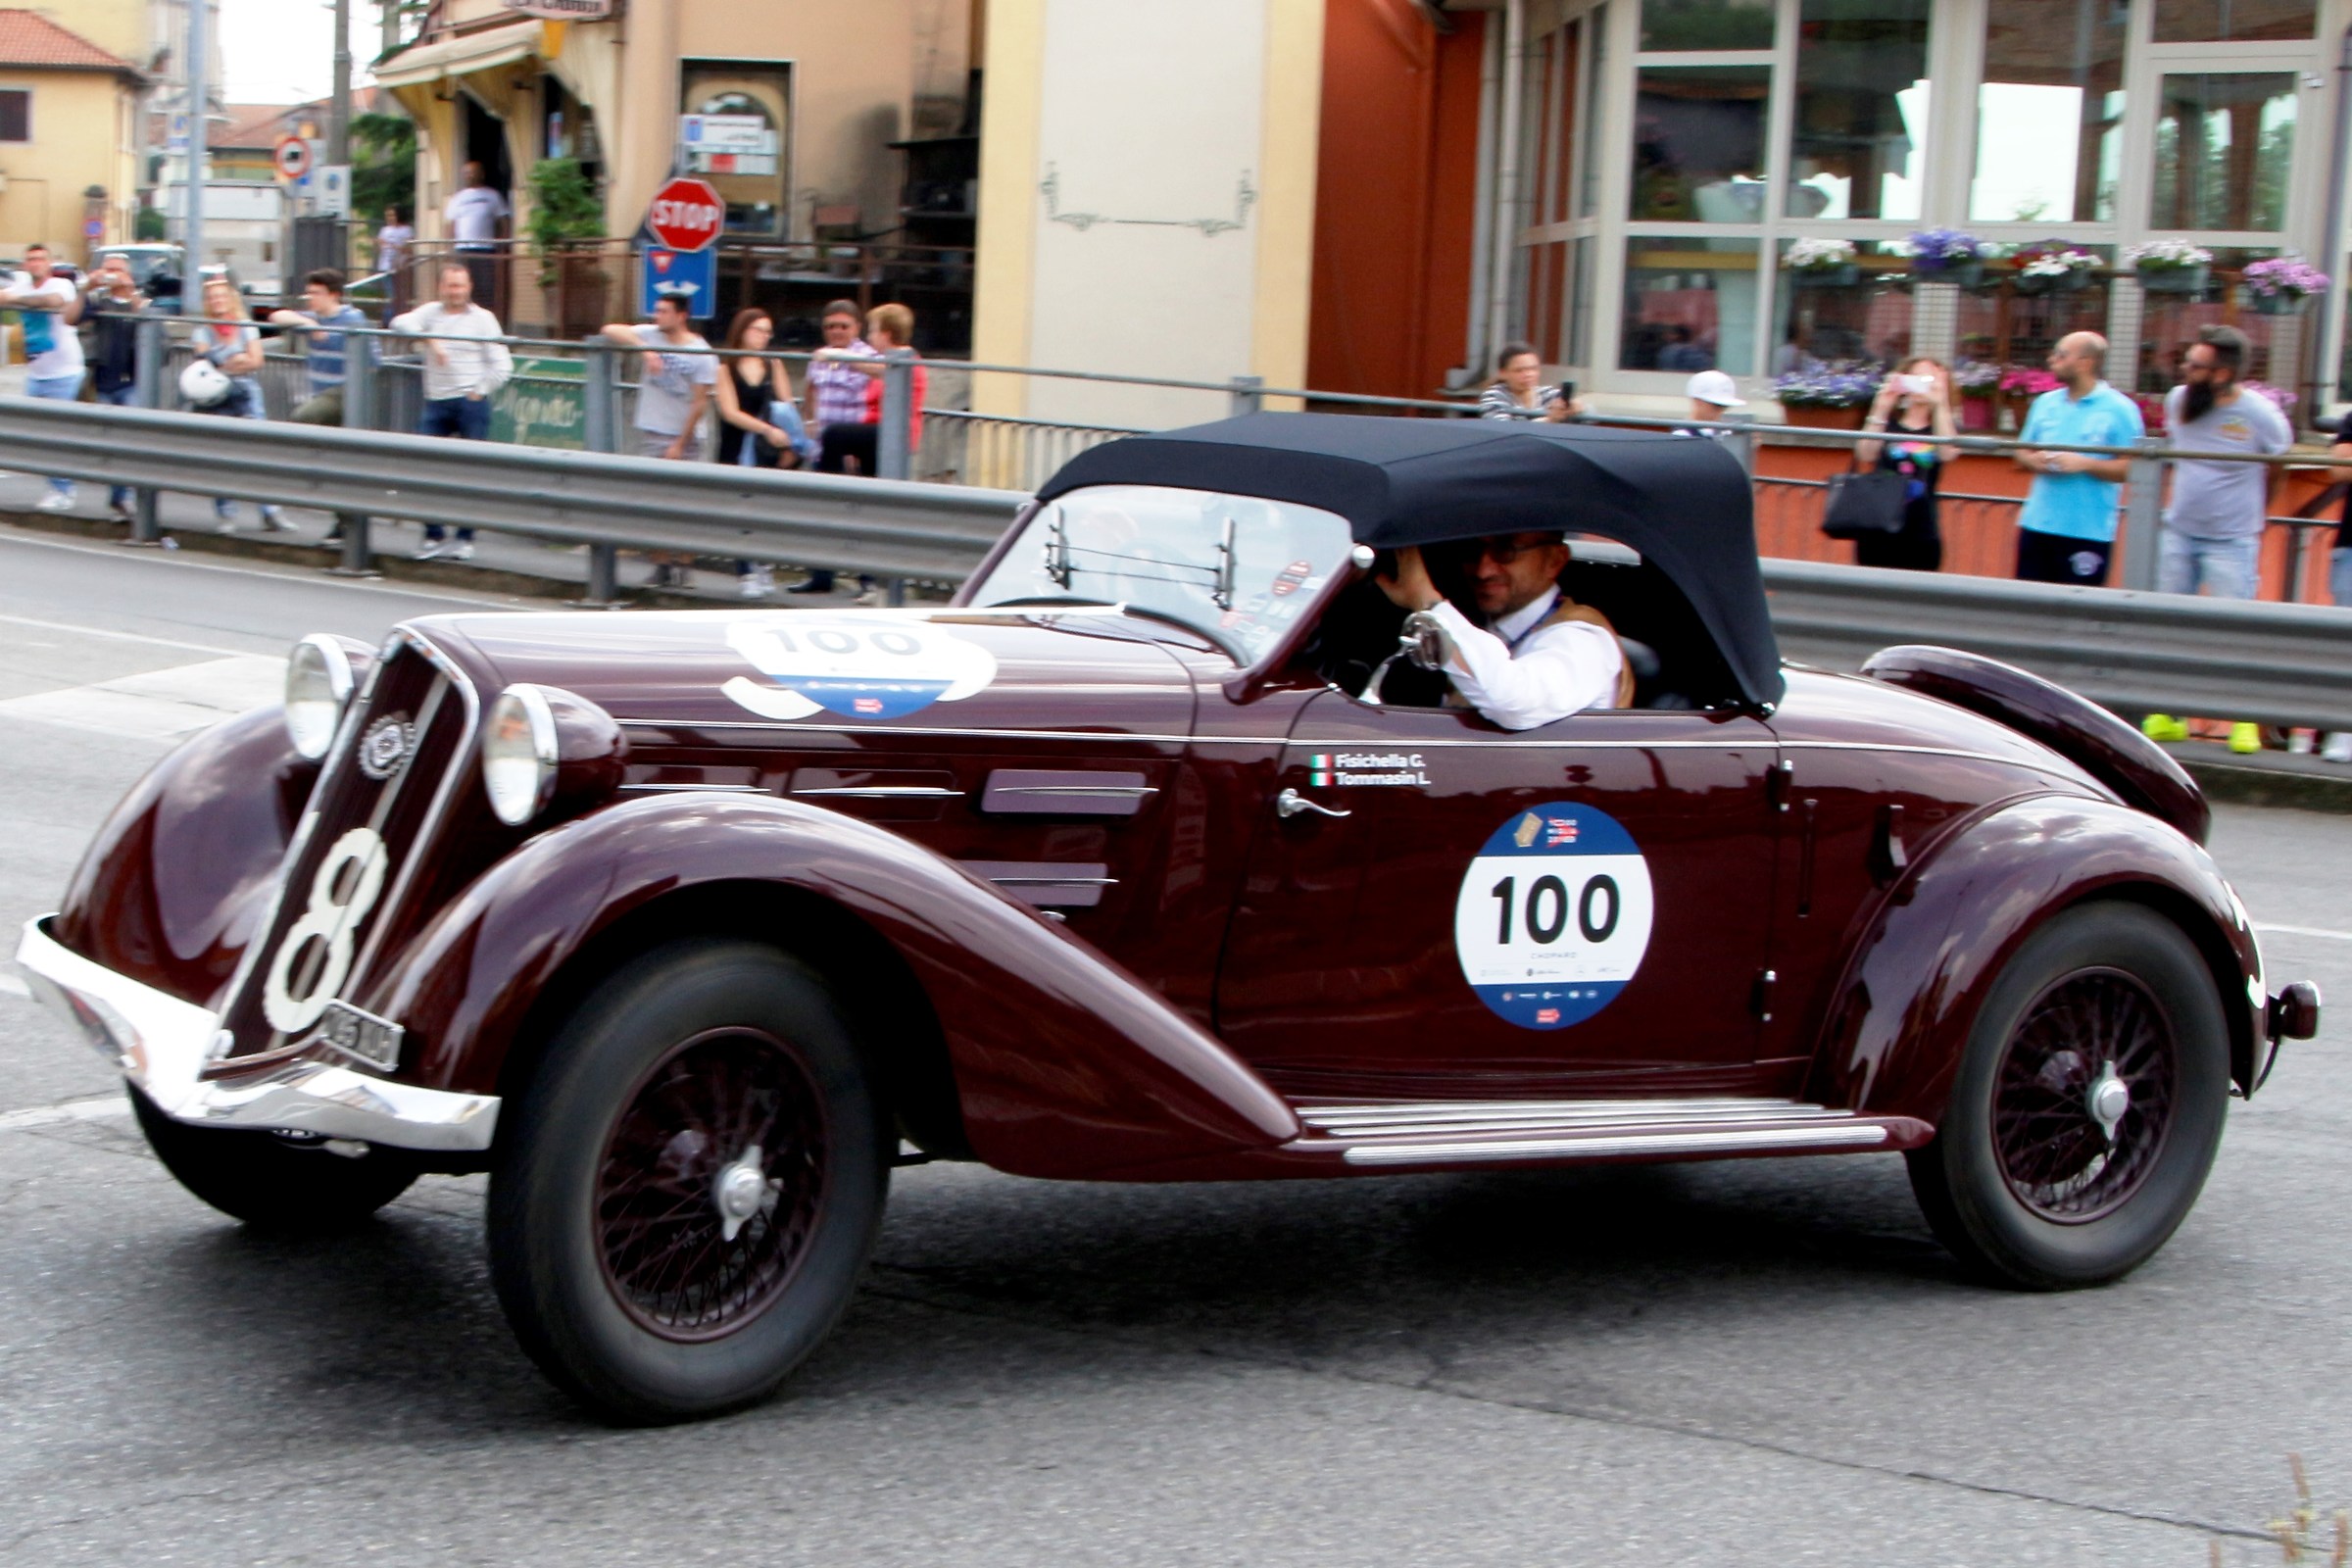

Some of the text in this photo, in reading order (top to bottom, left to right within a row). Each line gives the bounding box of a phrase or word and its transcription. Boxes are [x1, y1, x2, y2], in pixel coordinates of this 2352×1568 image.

[651, 198, 719, 231] STOP
[764, 629, 922, 656] 100
[1335, 754, 1408, 767] Fisichella
[1335, 770, 1416, 785] Tommasin
[1492, 873, 1620, 945] 100
[264, 827, 389, 1033] 8
